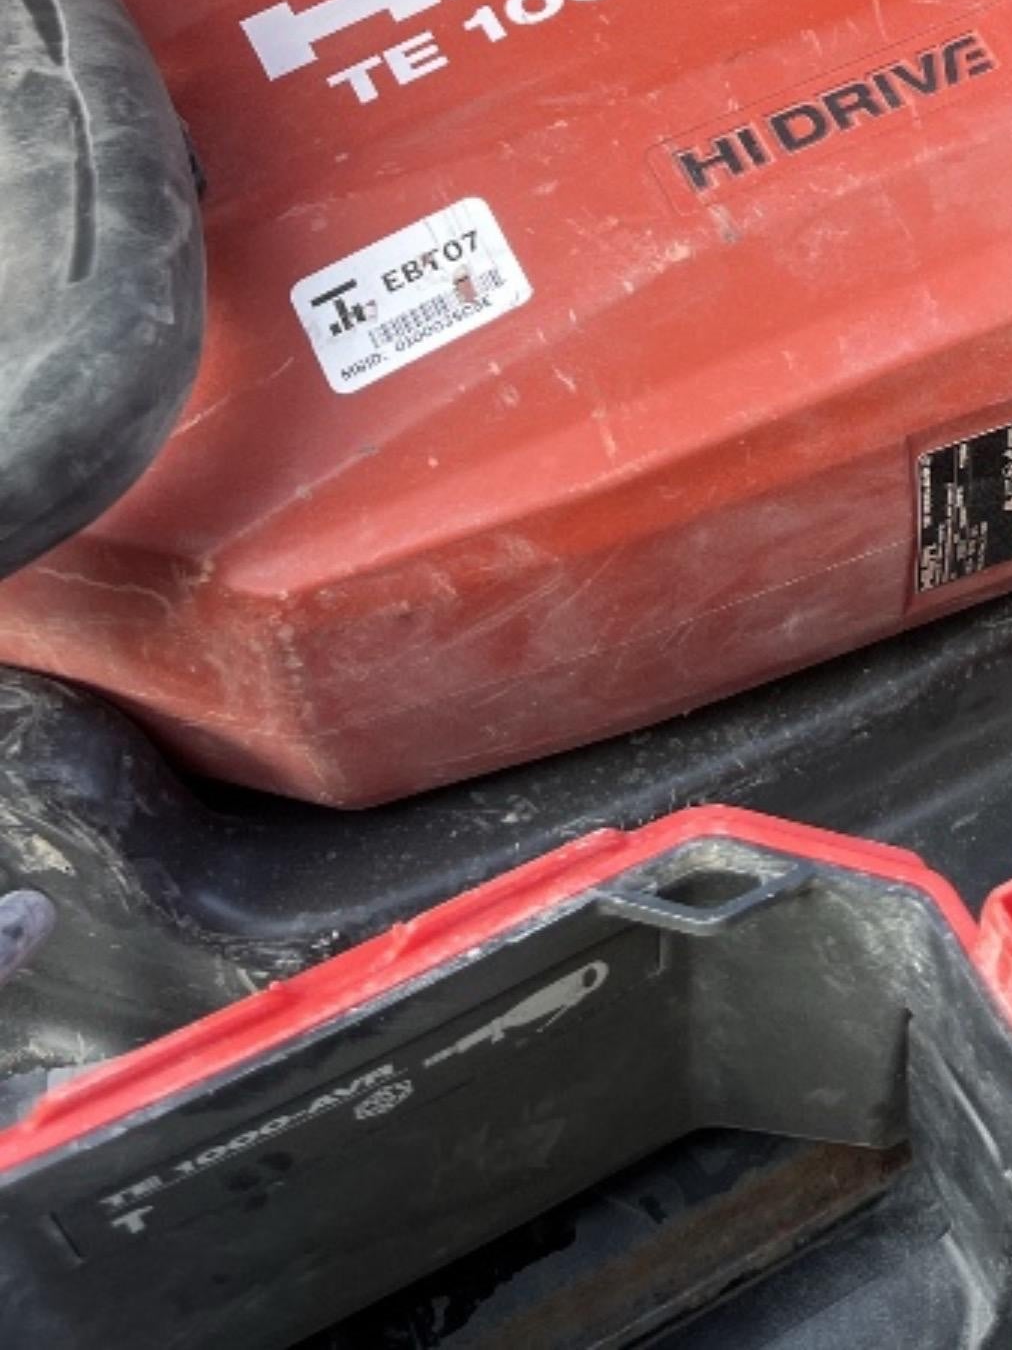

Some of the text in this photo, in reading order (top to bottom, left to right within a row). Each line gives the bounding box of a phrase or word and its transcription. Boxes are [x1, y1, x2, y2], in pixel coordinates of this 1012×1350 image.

[328, 31, 448, 104] TE
[676, 31, 998, 193] HI DRIVE
[175, 1062, 400, 1176] 1000-AVR
